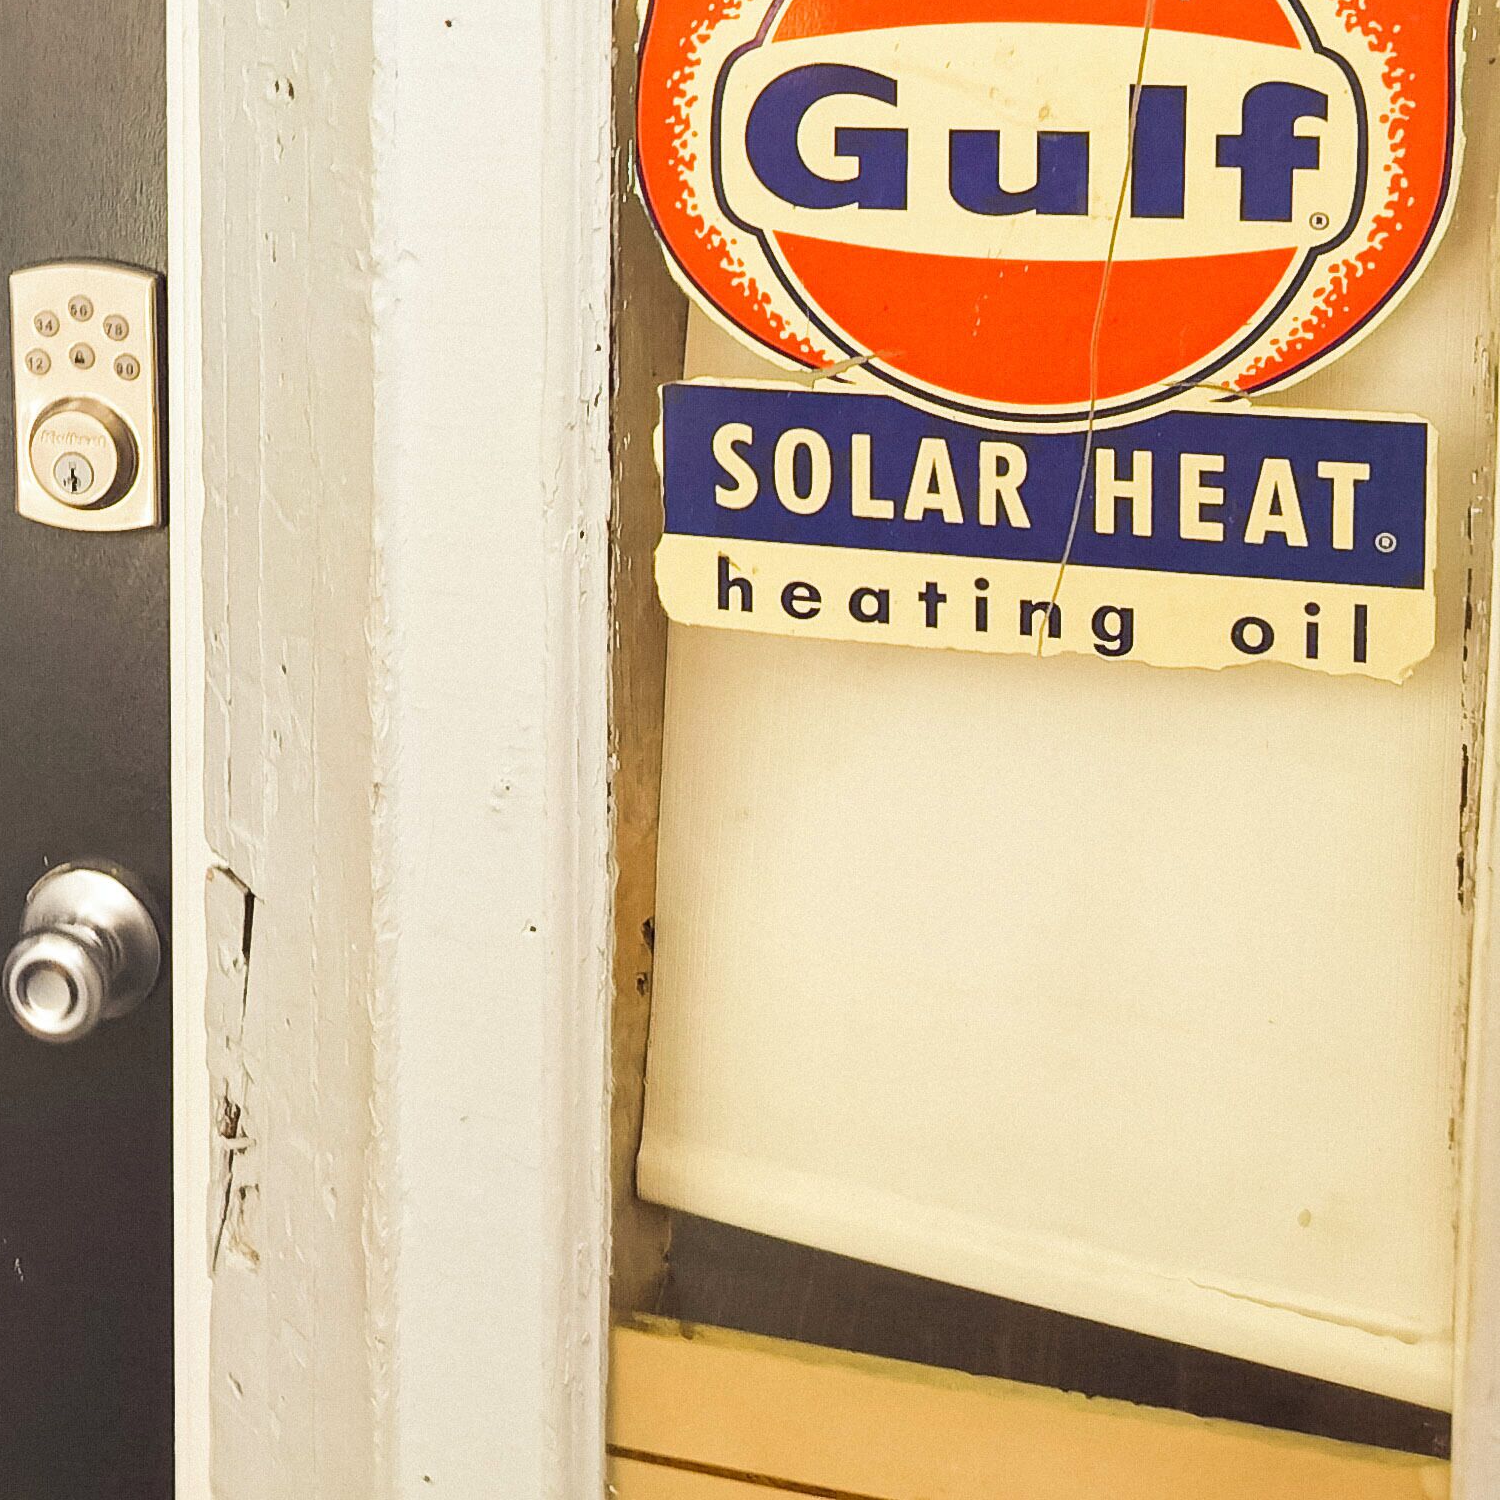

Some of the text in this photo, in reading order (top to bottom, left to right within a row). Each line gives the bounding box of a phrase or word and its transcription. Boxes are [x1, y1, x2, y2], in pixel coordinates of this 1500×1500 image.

[711, 421, 1032, 530] SOLAR
[716, 555, 1369, 665] heating oil
